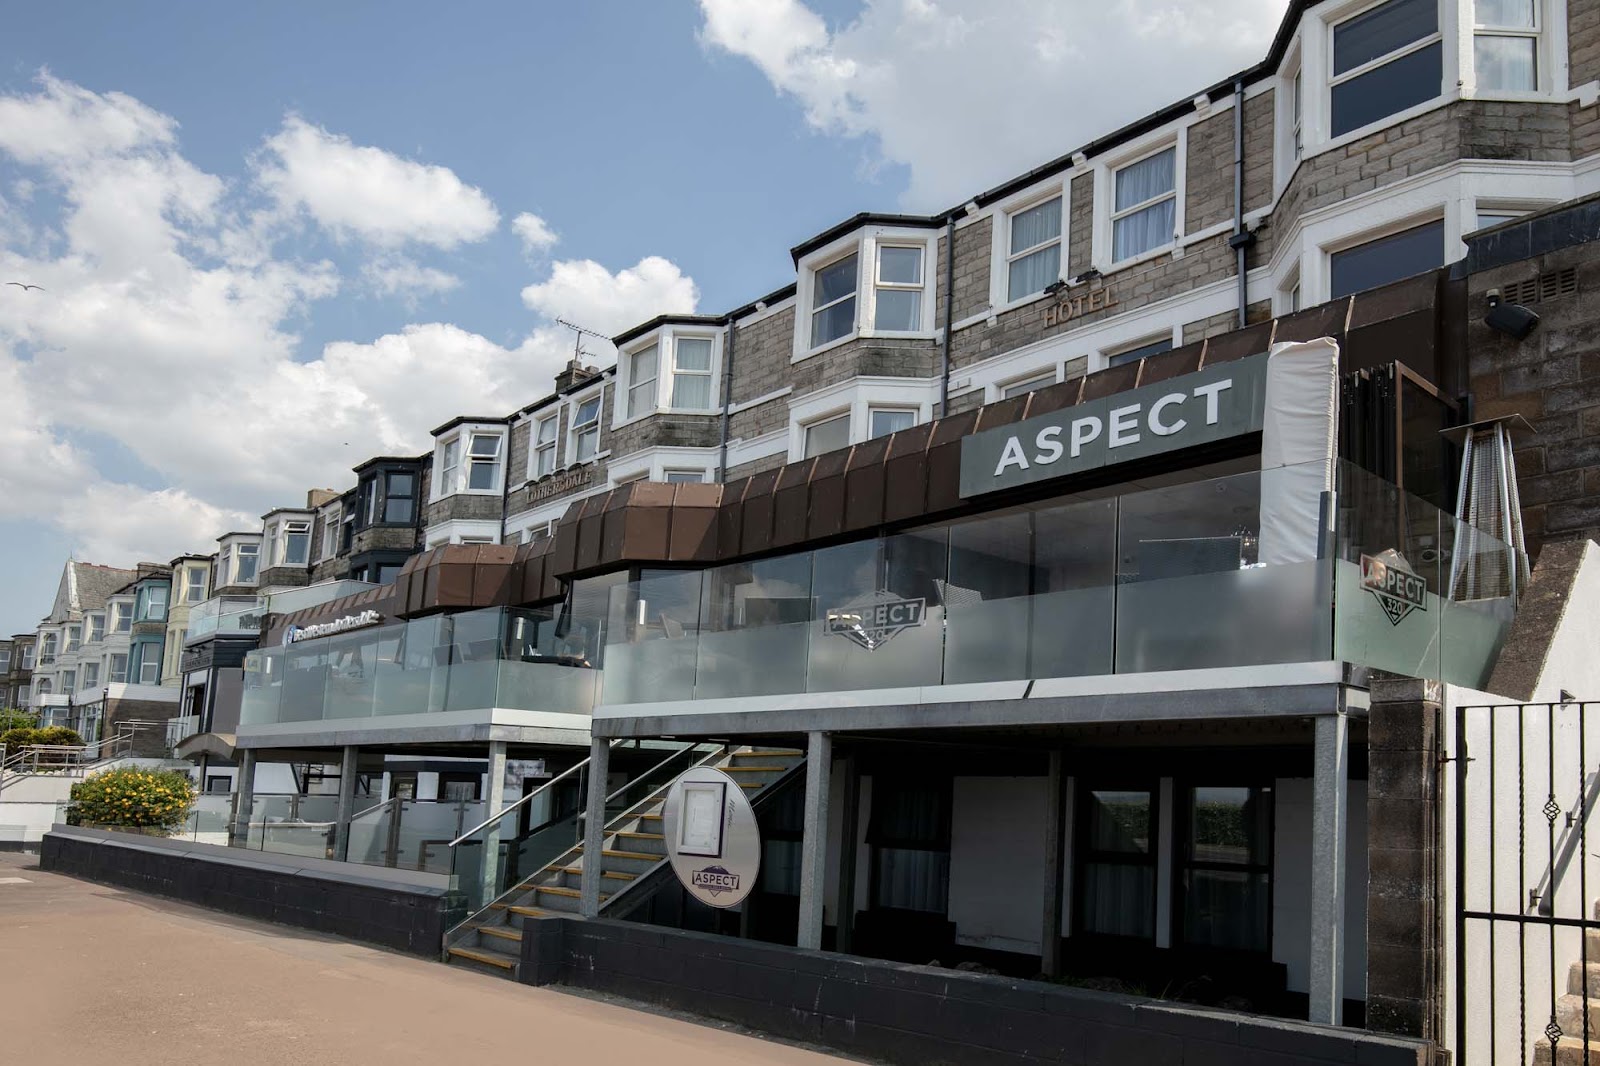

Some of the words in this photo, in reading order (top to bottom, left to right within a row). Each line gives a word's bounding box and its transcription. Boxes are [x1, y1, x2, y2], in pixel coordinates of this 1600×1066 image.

[1042, 287, 1120, 328] HOTEL
[993, 378, 1232, 476] ASPECT
[526, 472, 591, 503] LOTHERSDALE
[1364, 561, 1423, 601] ASPECT
[1386, 598, 1403, 615] 320
[695, 873, 737, 886] ASPECT
